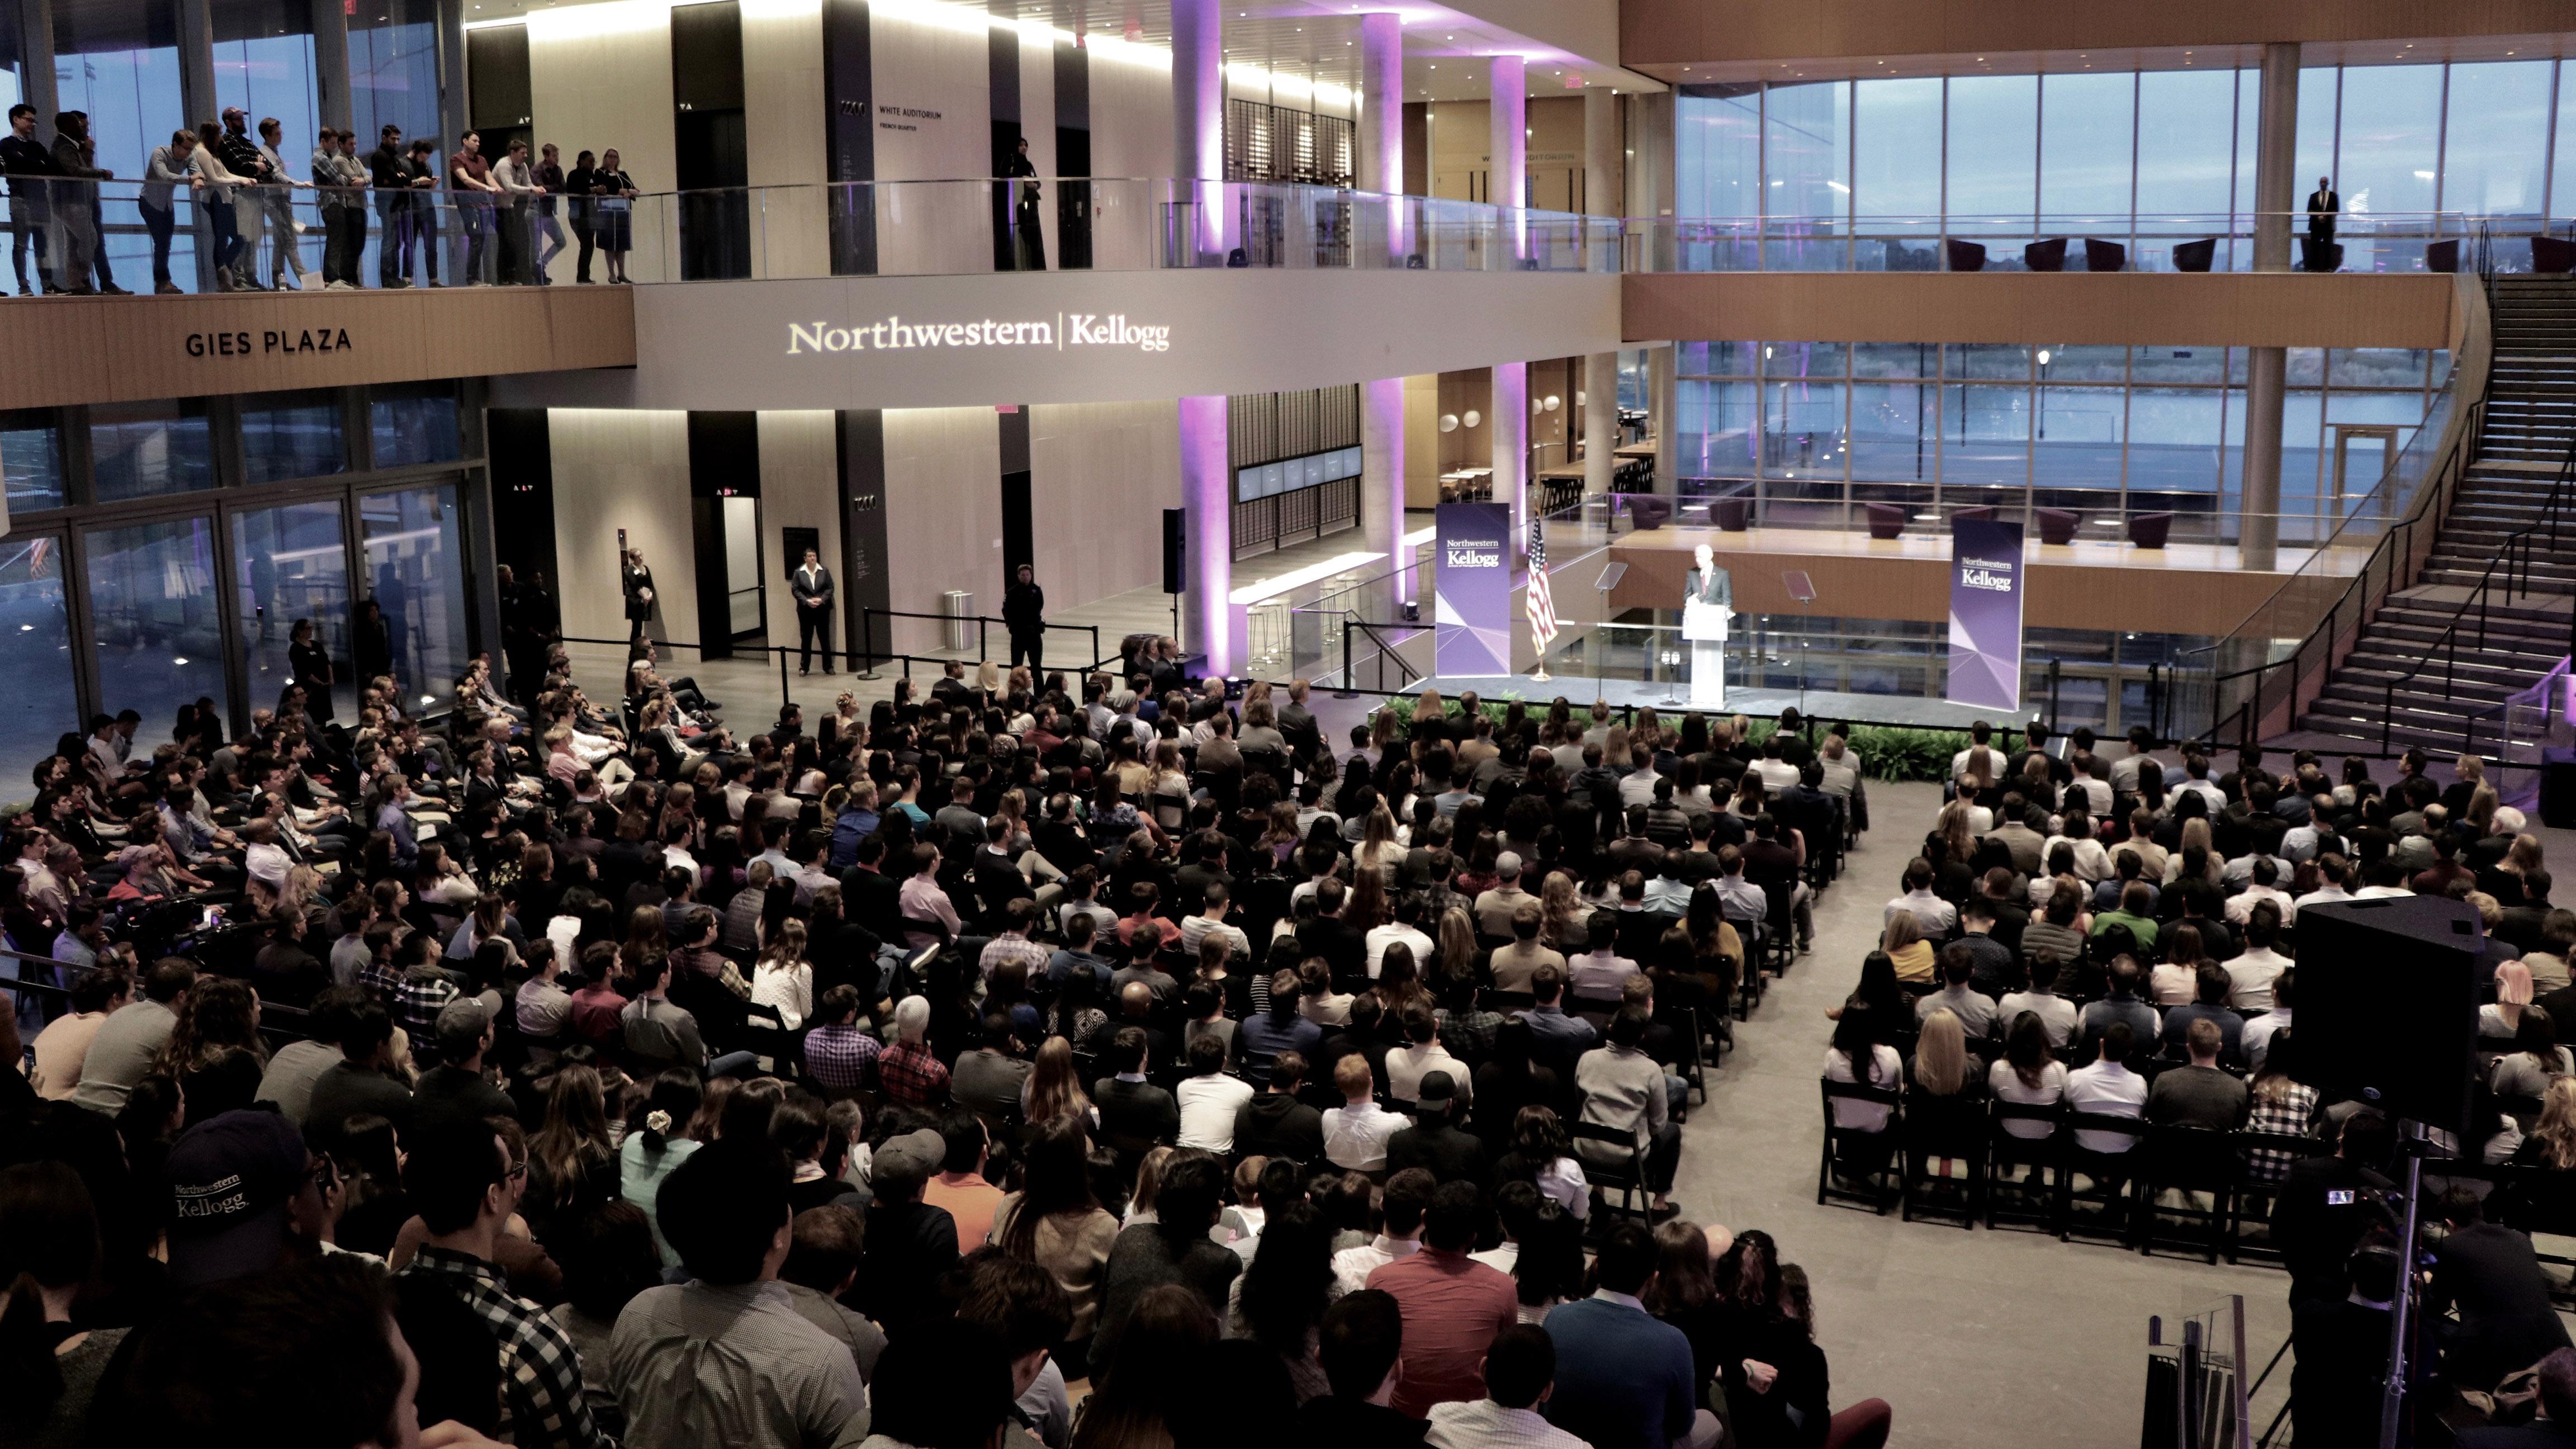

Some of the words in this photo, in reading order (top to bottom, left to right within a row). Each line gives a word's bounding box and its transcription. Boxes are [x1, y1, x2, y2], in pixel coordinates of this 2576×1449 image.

[841, 100, 865, 117] 2200
[879, 106, 900, 116] WHITE
[902, 107, 941, 120] AUDITORIUM
[186, 332, 251, 357] GIES
[264, 328, 352, 353] PLAZA
[787, 316, 1052, 354] Northwestern
[1070, 314, 1170, 352] Kellogg
[854, 495, 877, 512] 1200
[1447, 550, 1499, 567] Kellogg
[1962, 557, 2012, 570] Northwestern
[1962, 569, 2012, 592] Kellogg
[174, 1175, 240, 1194] Northwestern
